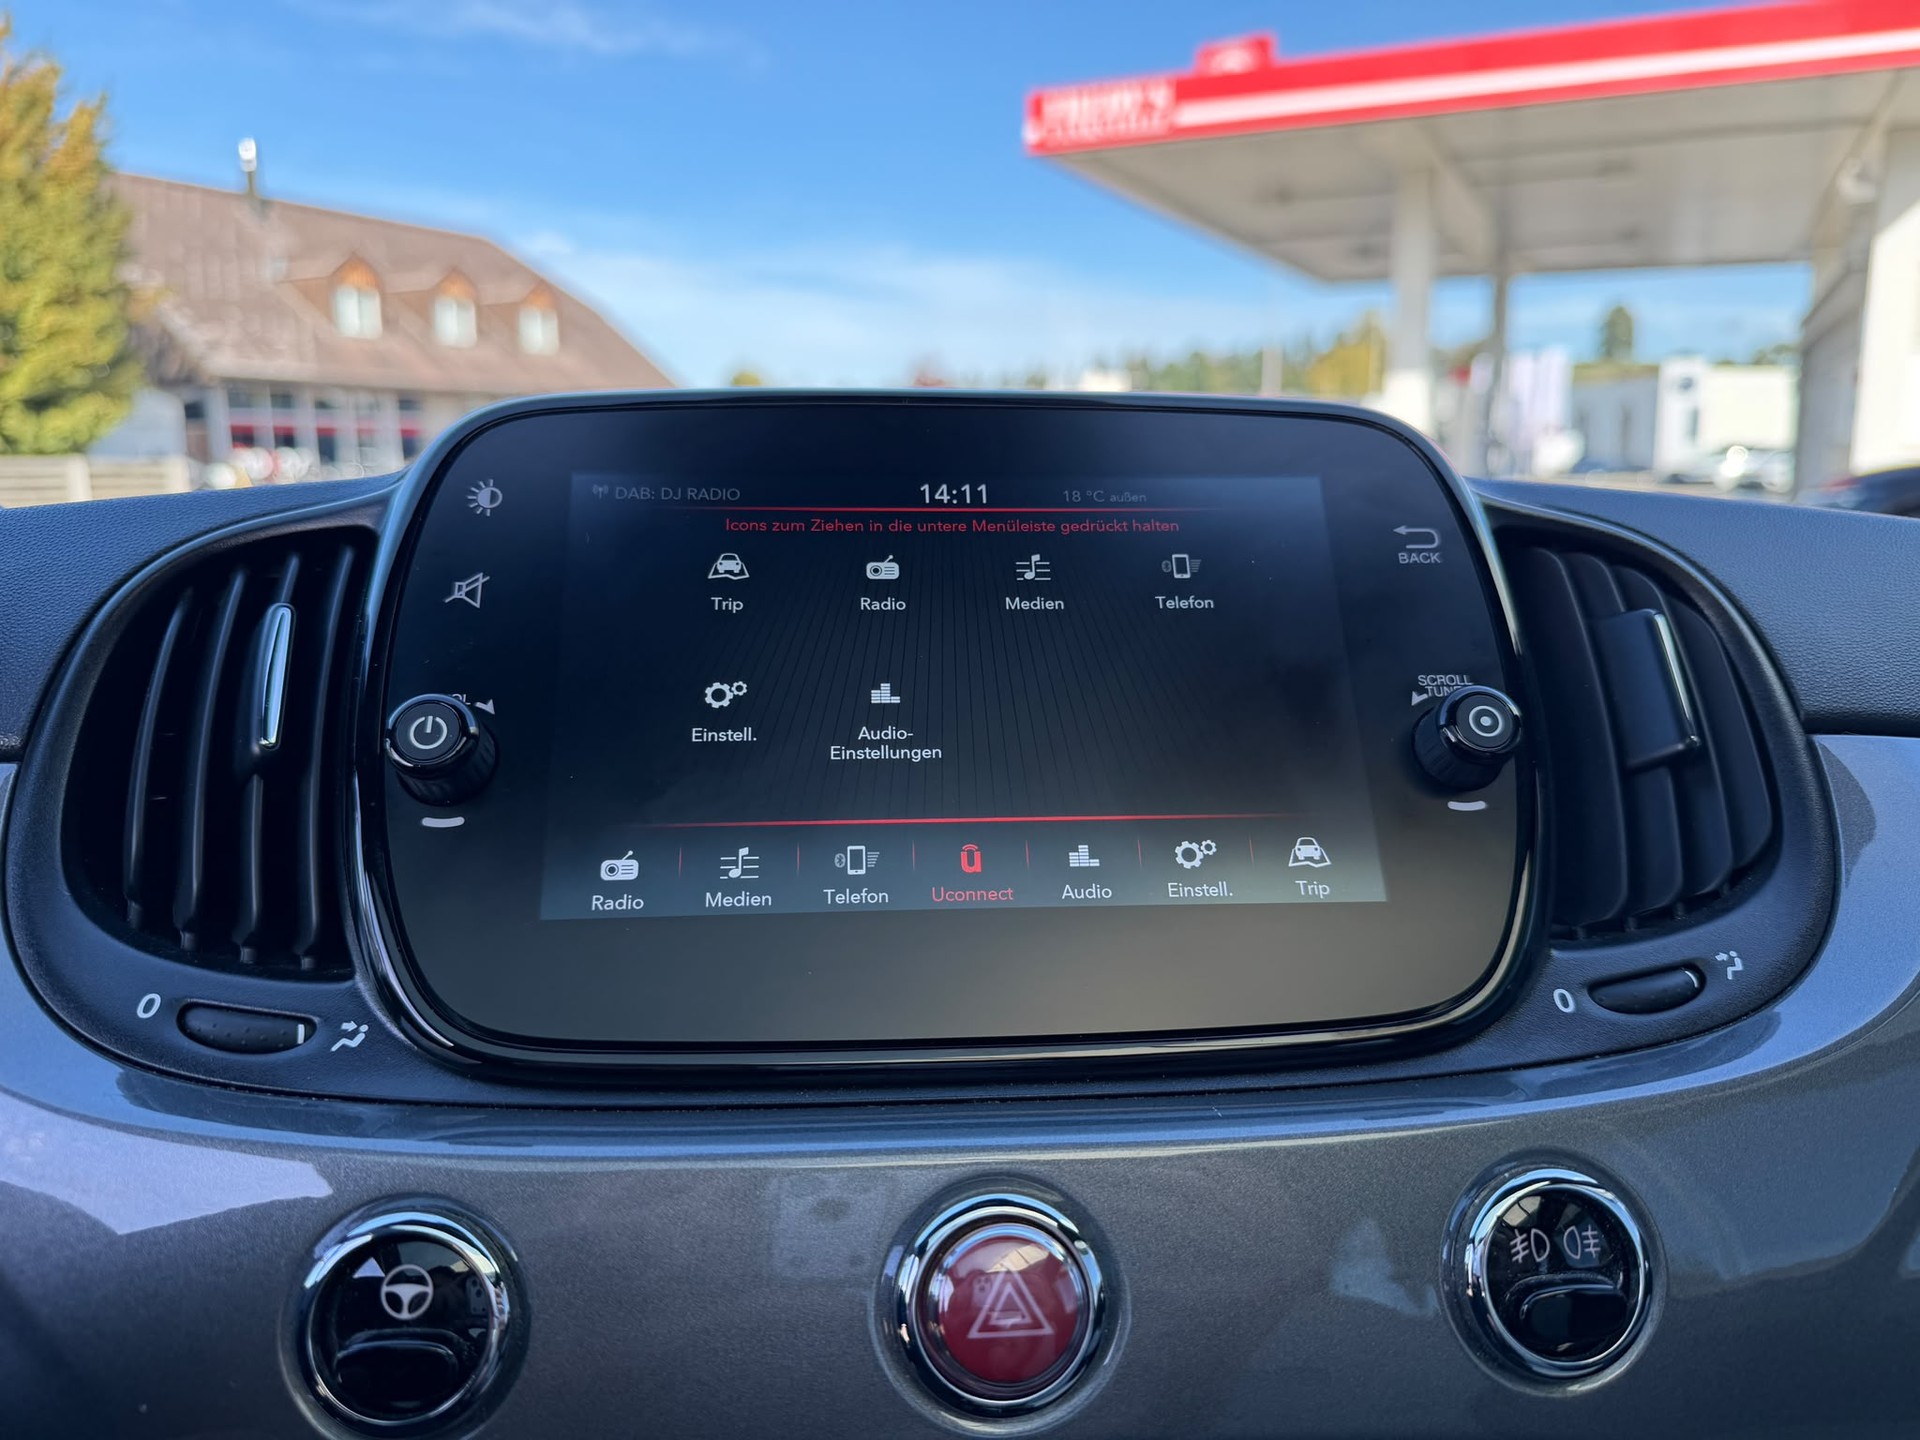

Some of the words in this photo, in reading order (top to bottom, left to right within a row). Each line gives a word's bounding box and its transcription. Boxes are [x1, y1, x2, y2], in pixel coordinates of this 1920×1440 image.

[615, 487, 655, 501] DAB:
[661, 487, 683, 501] DJ
[687, 488, 741, 502] RADIO
[919, 483, 989, 505] 14:11
[1062, 490, 1081, 503] 18
[1109, 492, 1147, 503] außen
[725, 518, 768, 532] Icons
[772, 520, 806, 532] zum
[810, 518, 864, 533] Ziehen
[869, 519, 884, 532] in
[888, 519, 912, 533] die
[916, 520, 967, 533] untere
[971, 519, 1056, 533] Menüleiste
[1060, 519, 1129, 536] gedrückt
[1132, 519, 1180, 533] halten
[1397, 552, 1442, 565] BACK
[710, 597, 744, 614] Trip
[859, 597, 907, 612] Radio
[1004, 596, 1065, 611] Medien
[1155, 595, 1215, 610] Telefon
[1417, 674, 1474, 686] SCROLL
[1424, 685, 1462, 698] TUN
[691, 727, 758, 743] Einstell.
[858, 726, 914, 741] Audio-
[830, 745, 943, 762] Einstellungen
[823, 888, 889, 905] Telefon
[931, 886, 1014, 902] Uconnect
[1061, 883, 1113, 900] Audio
[1168, 880, 1234, 898] Einstell.
[1295, 880, 1331, 898] Trip
[591, 894, 645, 912] Radio
[704, 891, 773, 909] Medien
